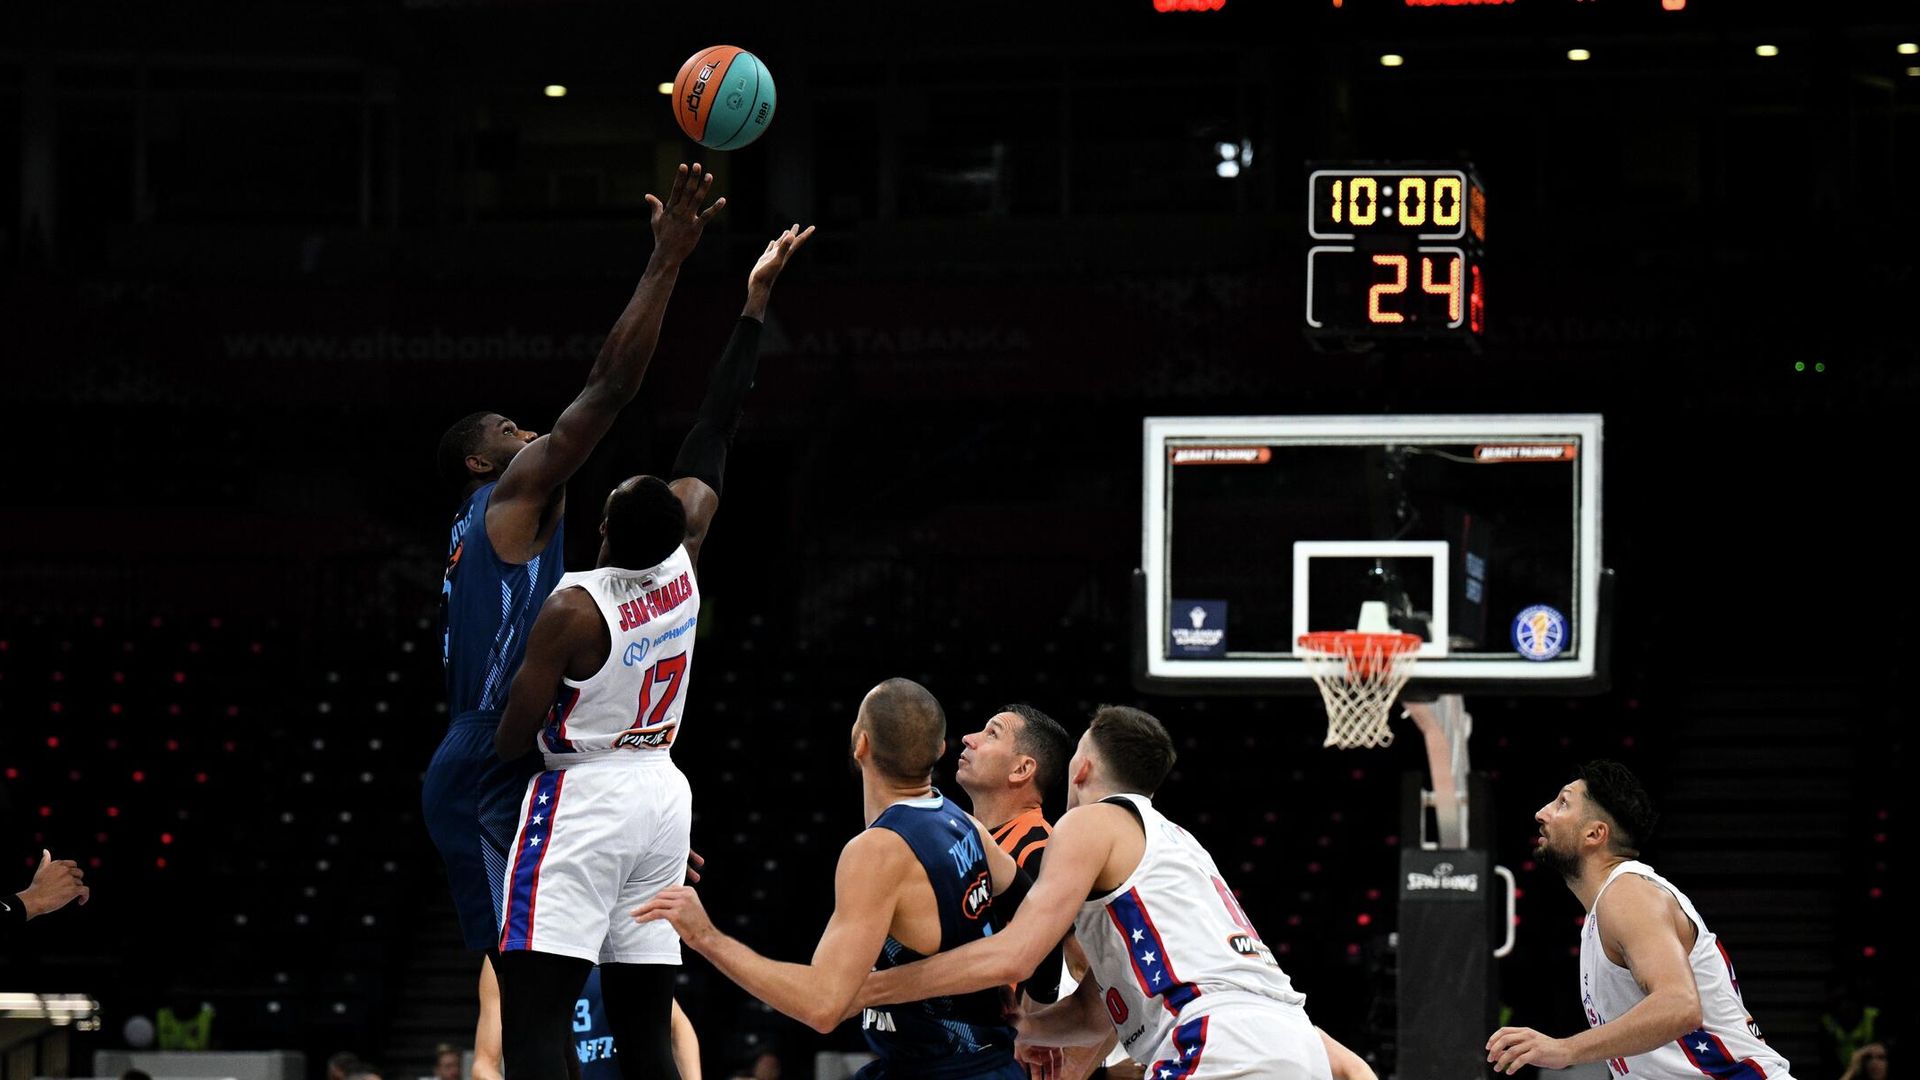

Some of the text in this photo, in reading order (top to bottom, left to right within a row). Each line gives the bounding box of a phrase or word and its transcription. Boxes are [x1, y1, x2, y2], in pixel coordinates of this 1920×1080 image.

[755, 101, 769, 125] FIBA
[1331, 177, 1461, 226] 10:00
[1368, 254, 1461, 323] 24
[617, 571, 693, 633] JEAN-CHARLES
[630, 650, 687, 730] 17
[1407, 872, 1479, 892] SPALDING
[572, 998, 592, 1033] 3
